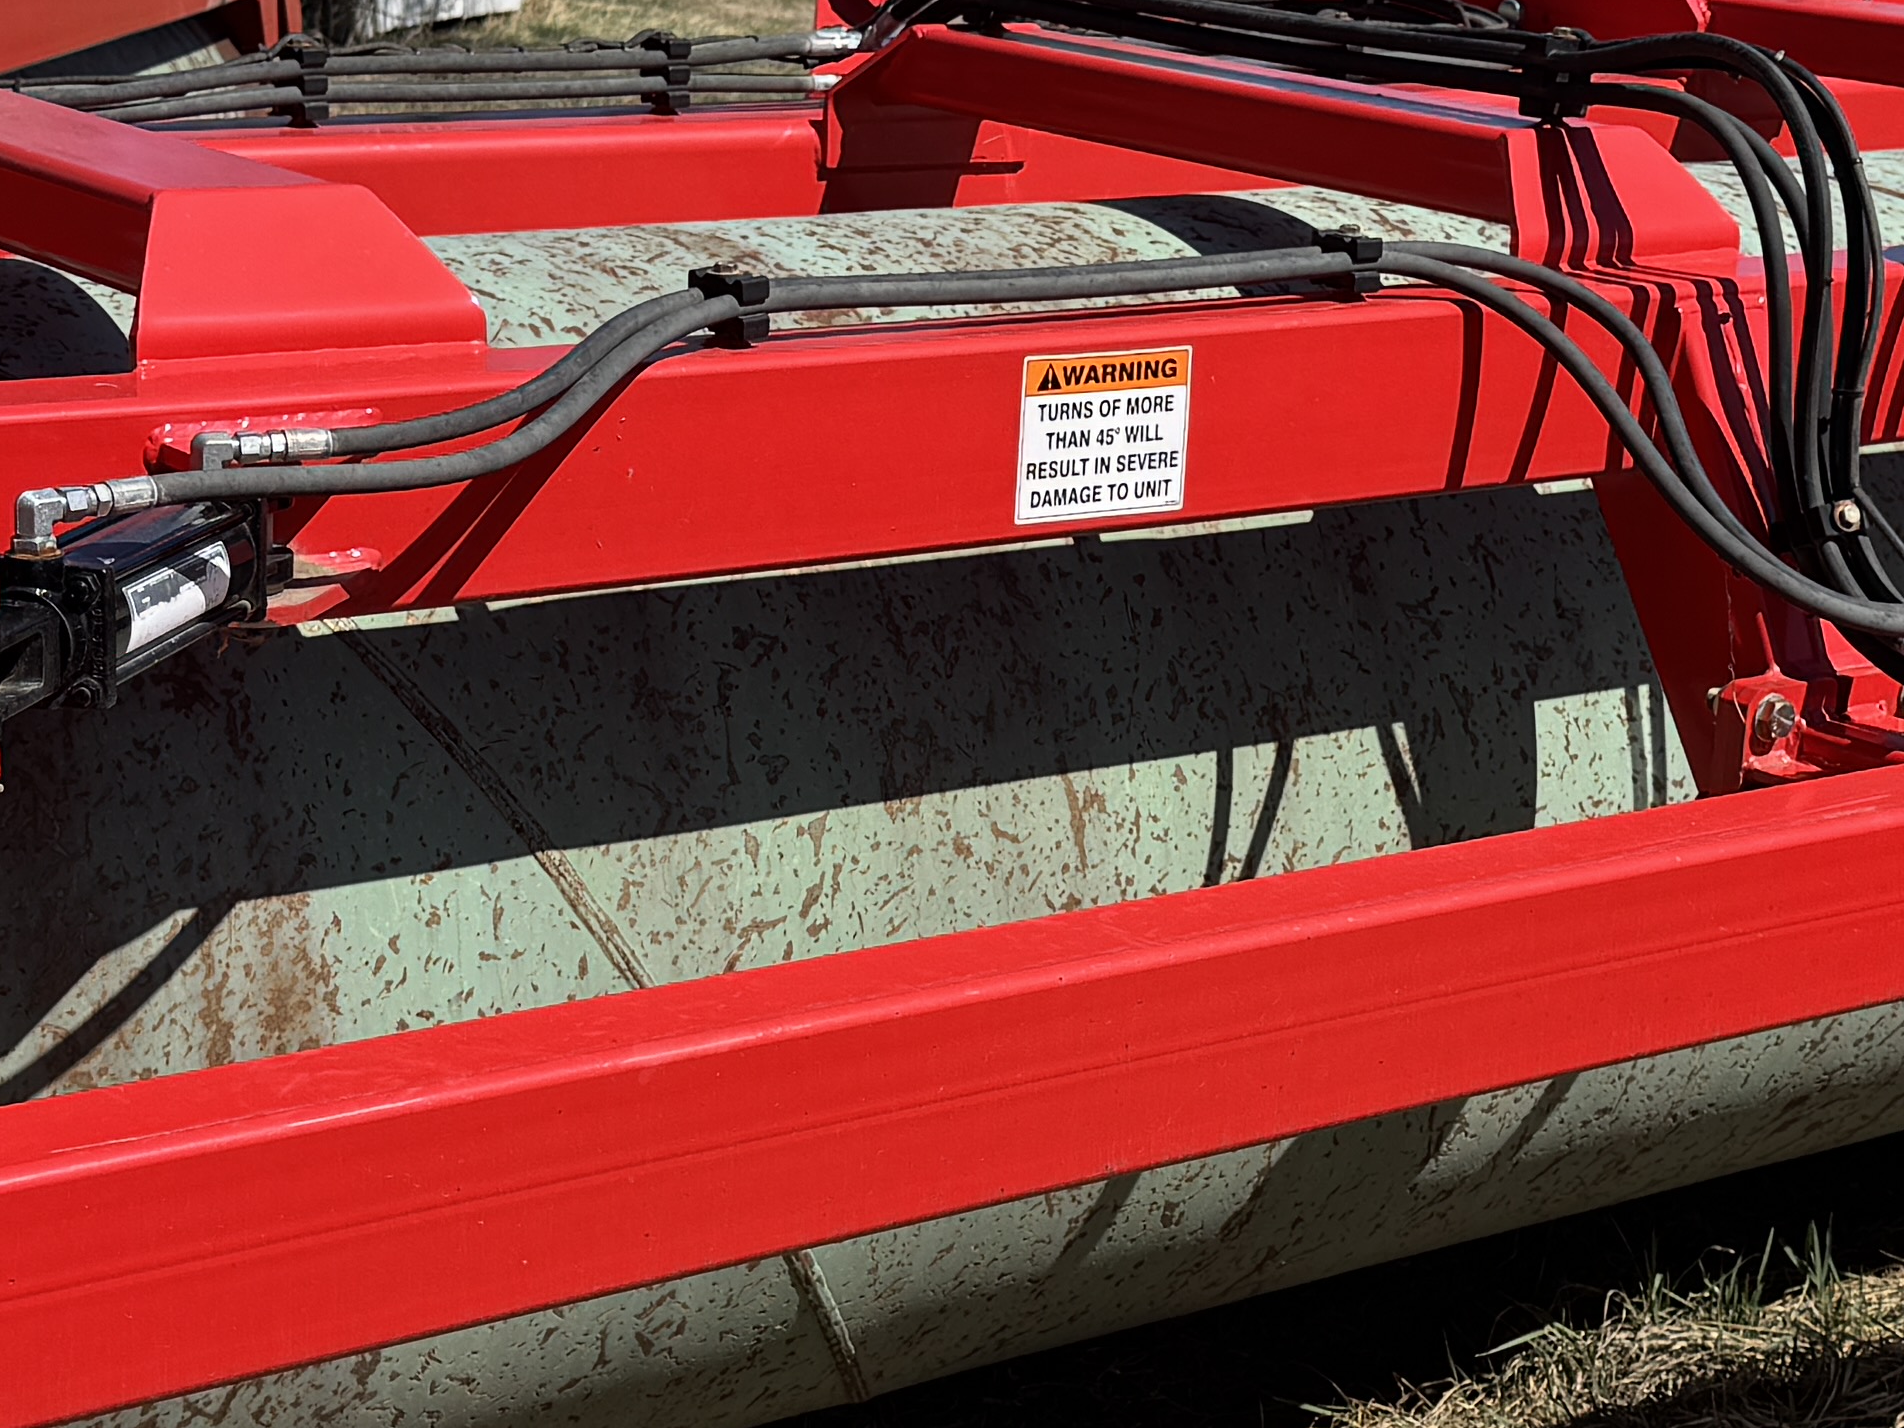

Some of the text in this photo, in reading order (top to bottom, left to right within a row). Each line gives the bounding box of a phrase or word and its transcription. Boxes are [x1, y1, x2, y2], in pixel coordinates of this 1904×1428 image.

[1063, 358, 1178, 386] WARNING
[1038, 394, 1174, 422] TURNS OF MORE
[1045, 430, 1090, 450] THAN
[1125, 424, 1163, 444] WILL
[1026, 451, 1179, 480] RESULT IN SEVERE
[1030, 479, 1172, 509] DAMAGE TO UNIT
